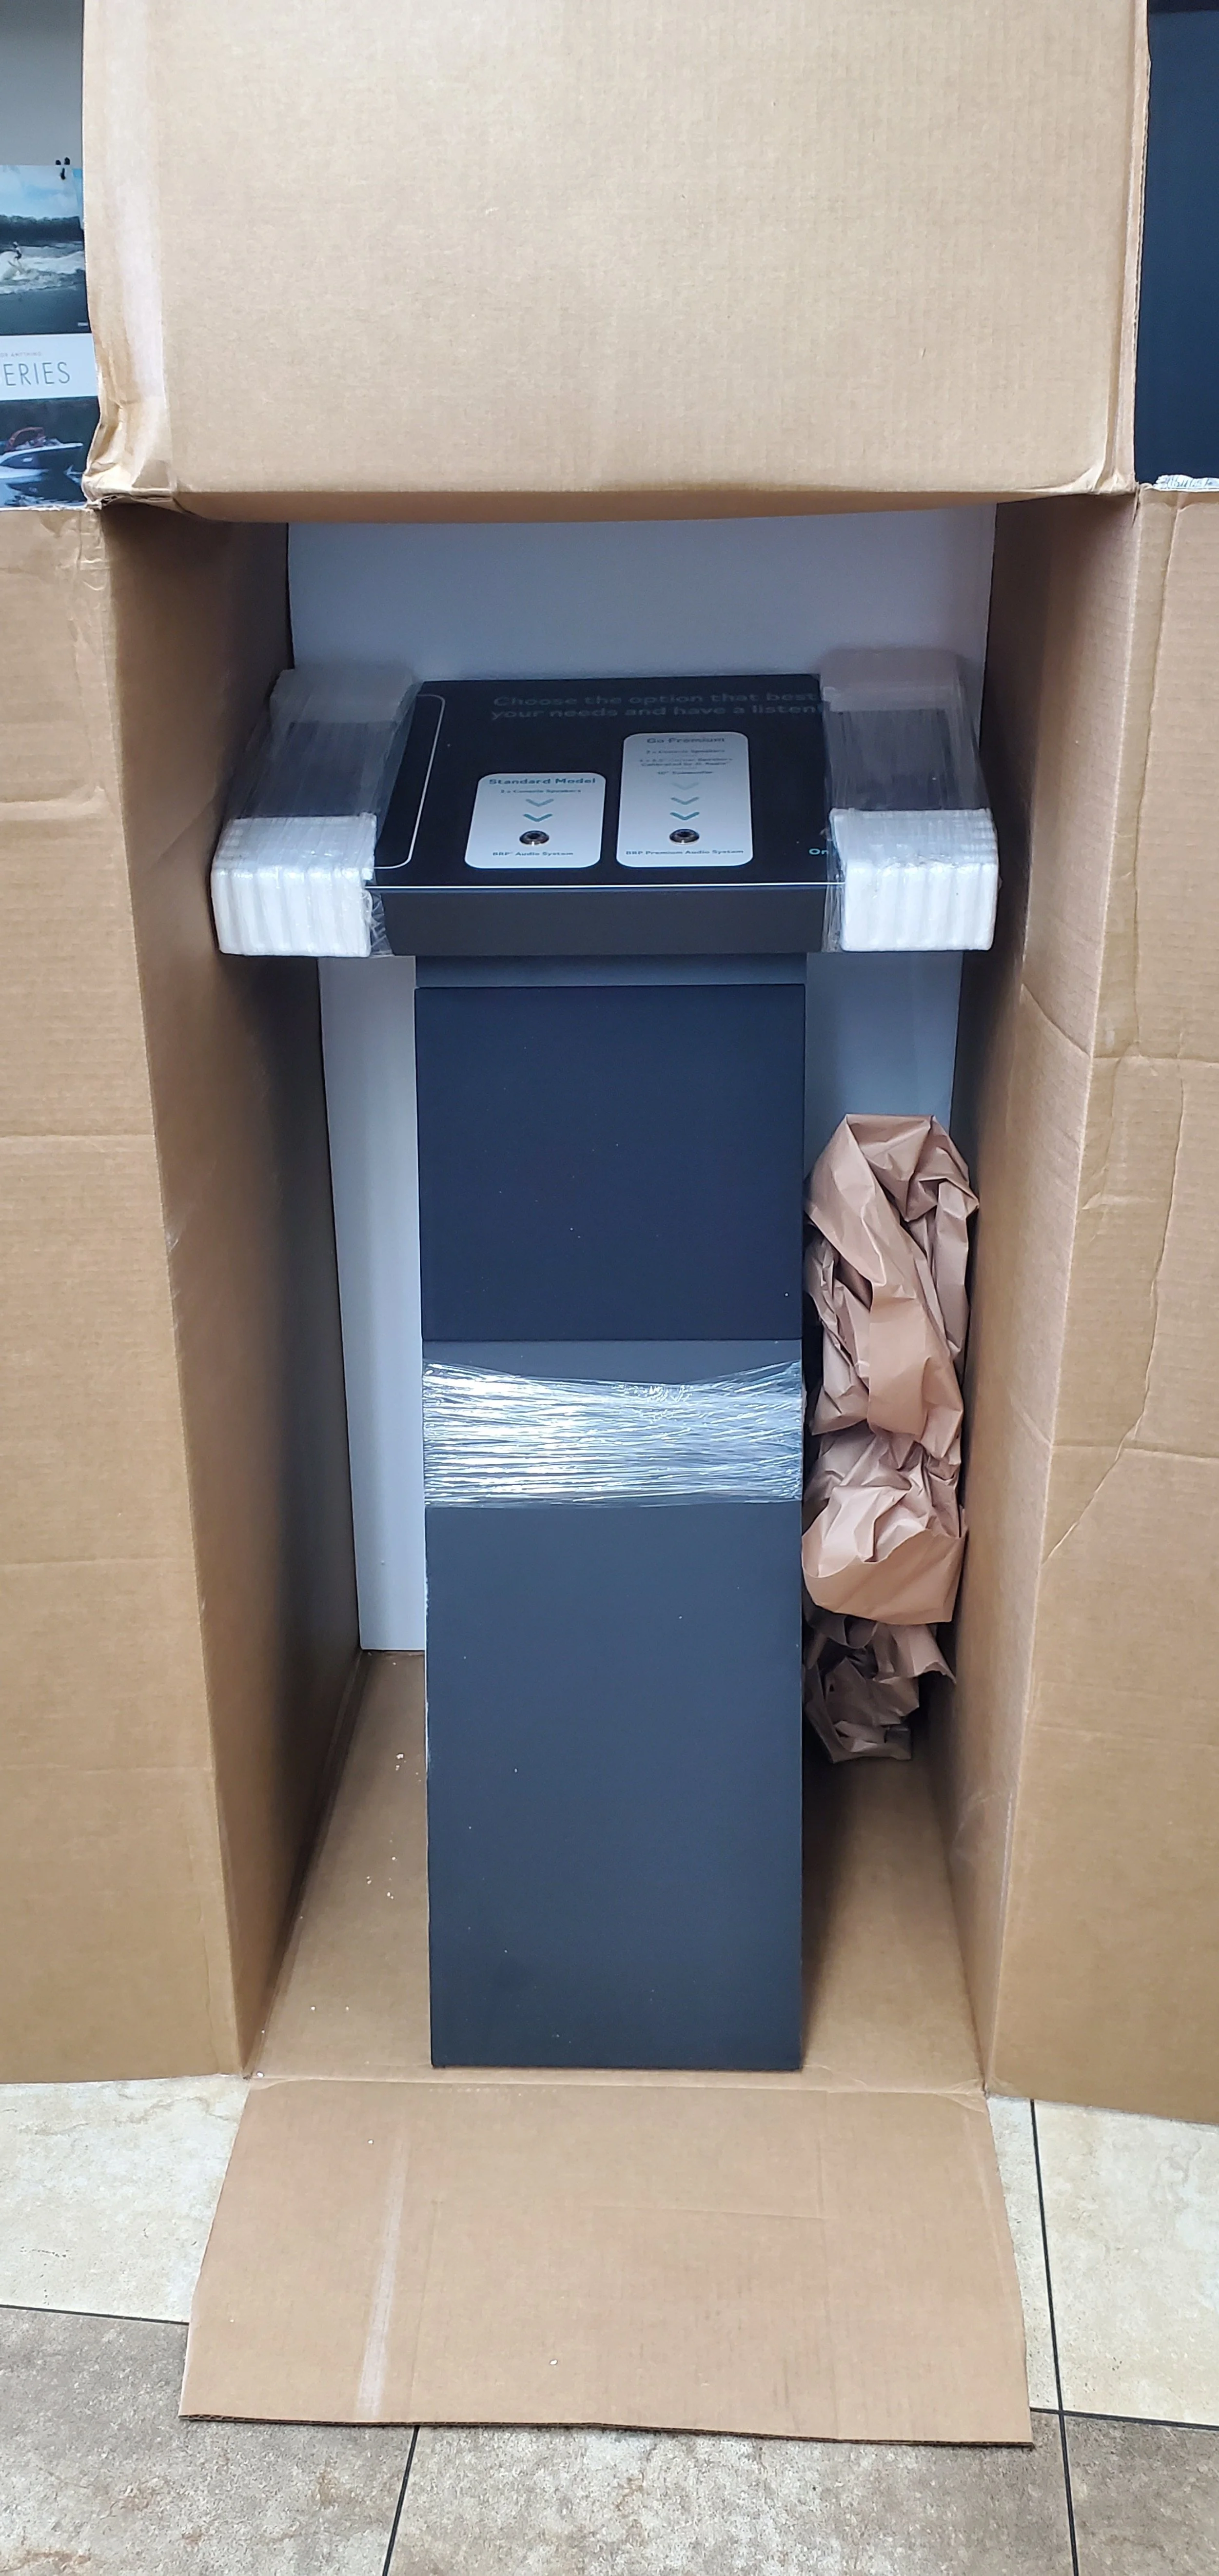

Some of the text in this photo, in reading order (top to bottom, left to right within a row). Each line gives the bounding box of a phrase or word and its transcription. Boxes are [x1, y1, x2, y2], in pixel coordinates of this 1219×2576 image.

[0, 361, 70, 386] ERIES
[493, 693, 818, 706] Choose the option that best
[491, 710, 545, 720] your
[550, 707, 618, 716] needs
[624, 707, 666, 716] and
[673, 706, 726, 715] have
